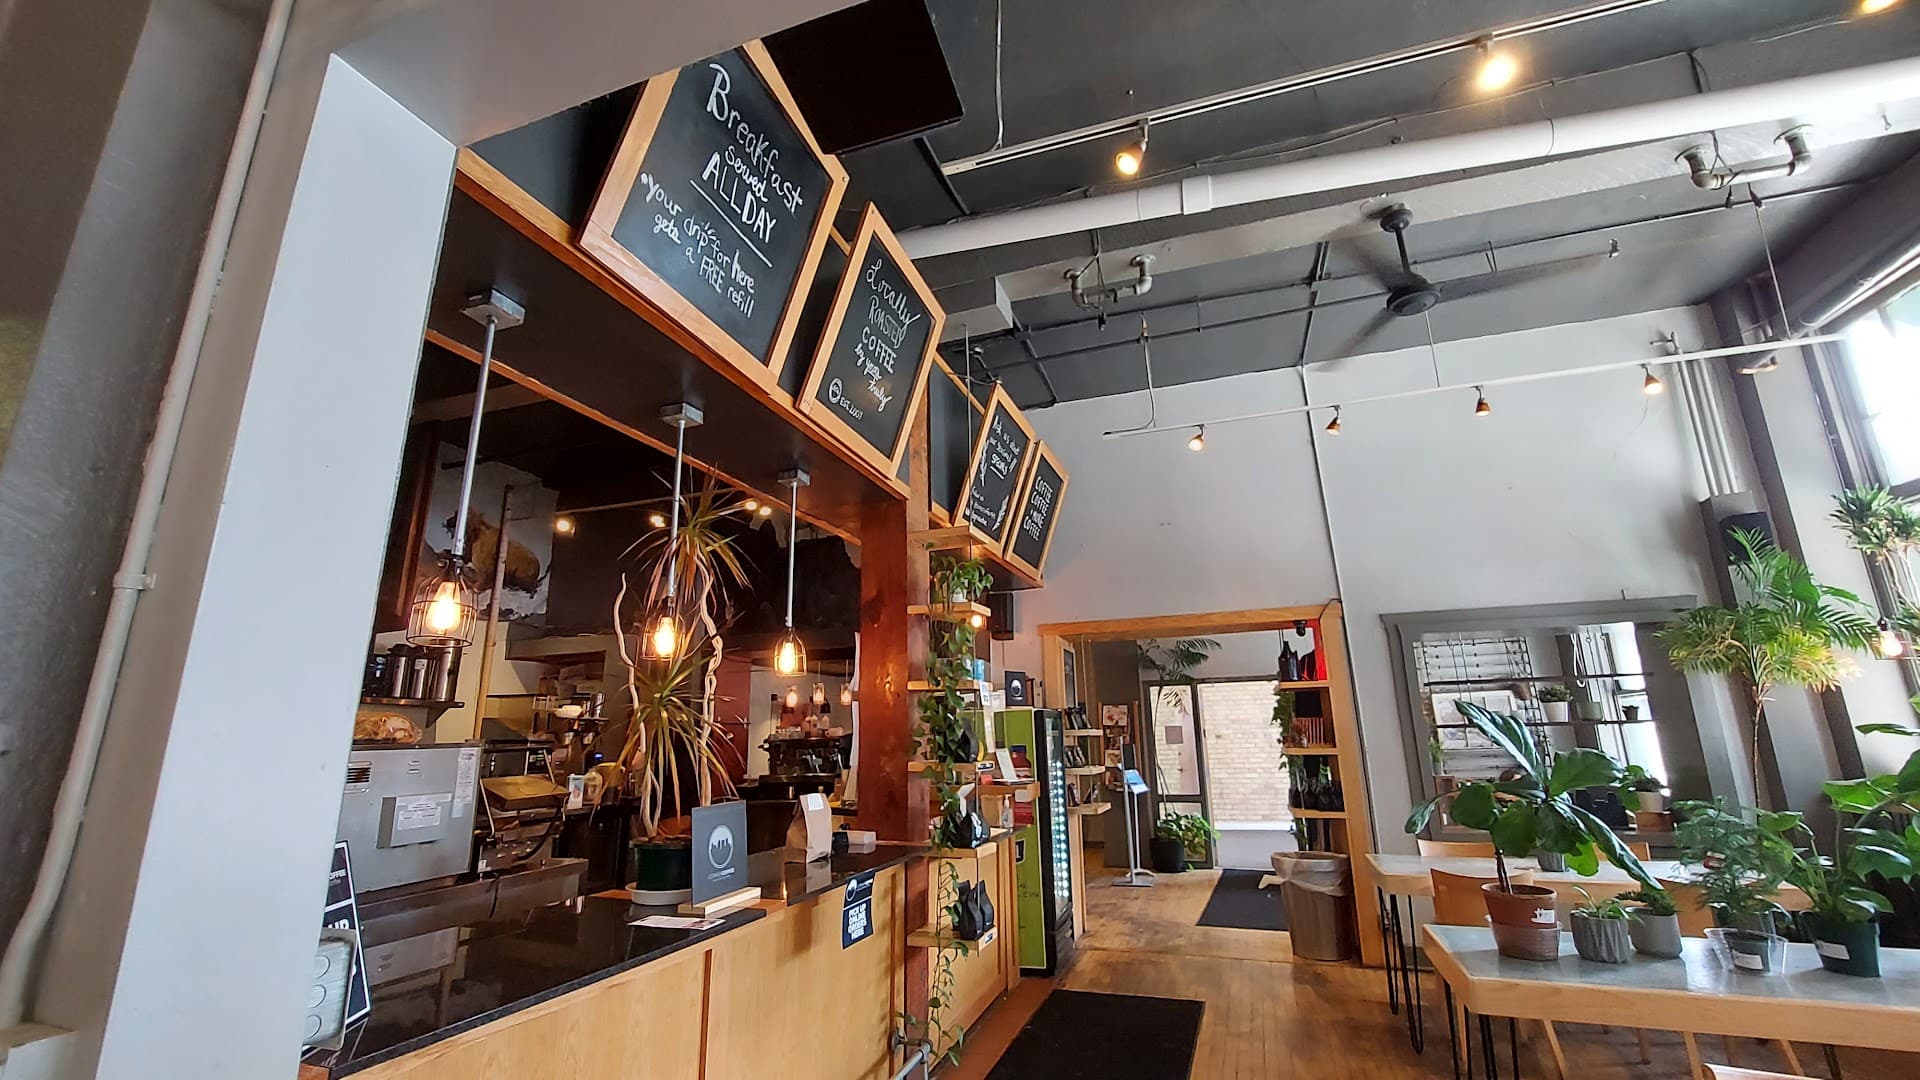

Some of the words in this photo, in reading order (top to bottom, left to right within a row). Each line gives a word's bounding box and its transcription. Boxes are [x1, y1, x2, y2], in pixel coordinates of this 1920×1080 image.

[706, 63, 803, 214] Breakfast
[725, 145, 768, 203] served
[685, 247, 695, 264] a
[699, 256, 726, 294] FREE
[727, 286, 755, 319] refill
[711, 240, 731, 267] for
[731, 249, 755, 294] here
[865, 258, 921, 338] Locally
[868, 295, 905, 348] ROASTED
[854, 343, 866, 367] by
[862, 326, 898, 375] COFFEE
[1031, 491, 1049, 516] COFFEE
[1035, 476, 1053, 503] COFFEE
[1023, 515, 1041, 541] COFFEE
[328, 869, 347, 880] OFFEE
